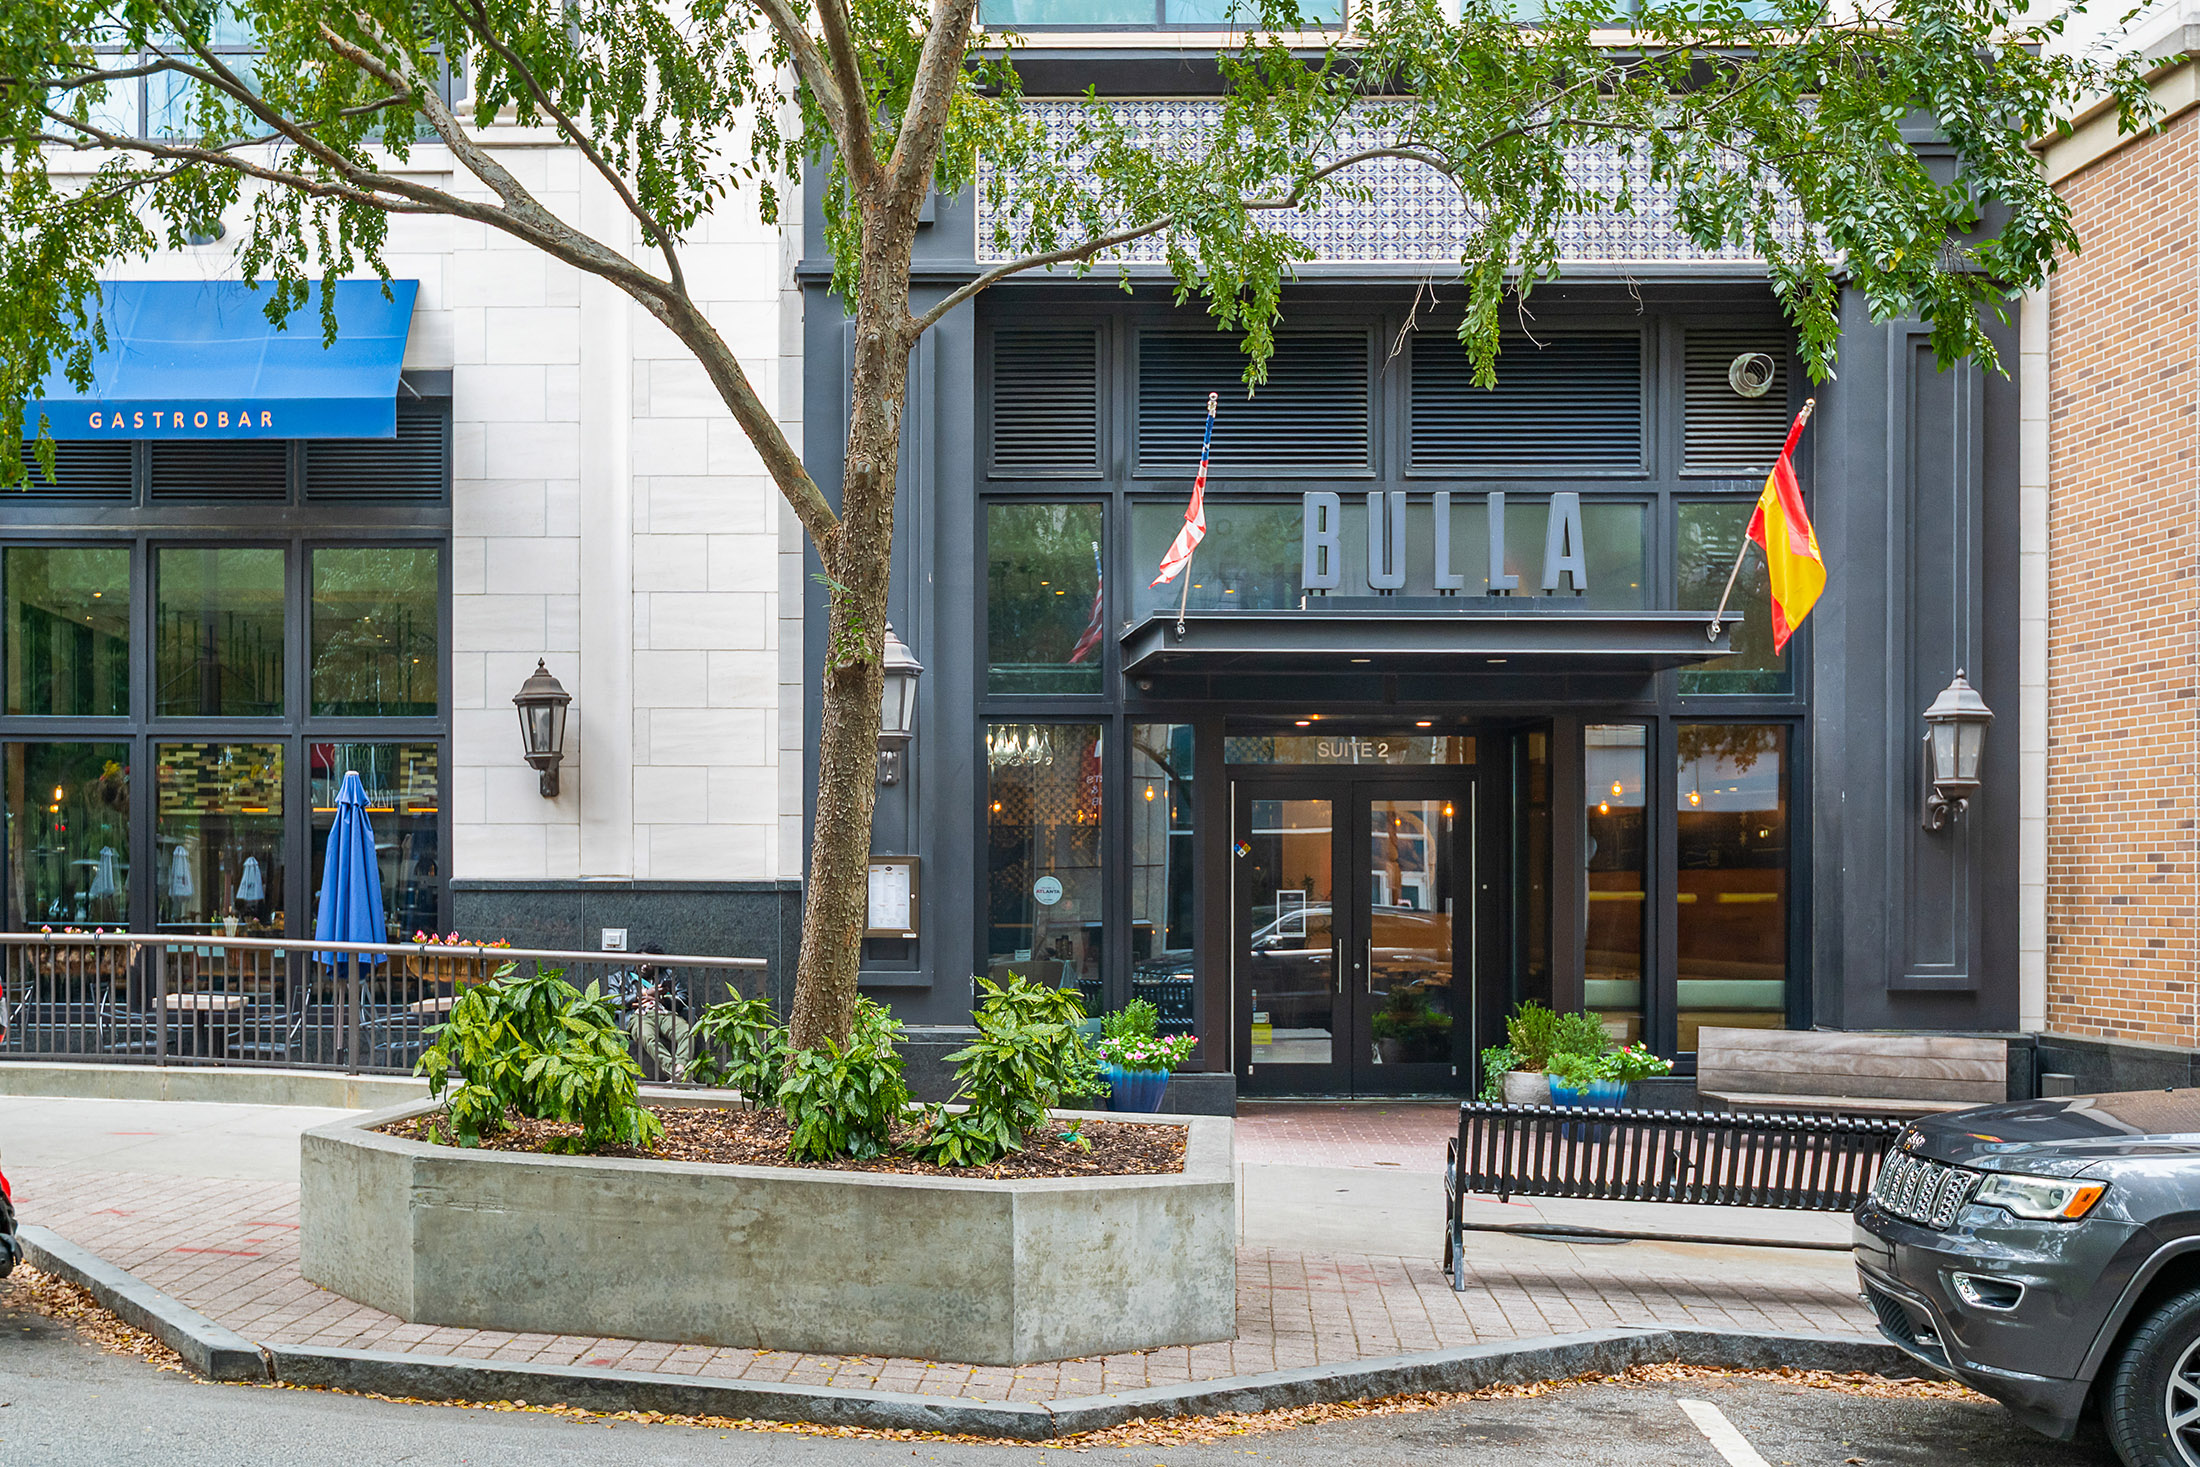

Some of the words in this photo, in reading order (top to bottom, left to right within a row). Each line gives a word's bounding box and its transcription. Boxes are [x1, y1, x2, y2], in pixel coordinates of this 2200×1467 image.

[88, 410, 274, 430] GASTROBAR
[1301, 491, 1588, 592] BULLA
[1316, 742, 1373, 758] SUITE
[1377, 742, 1389, 758] 2
